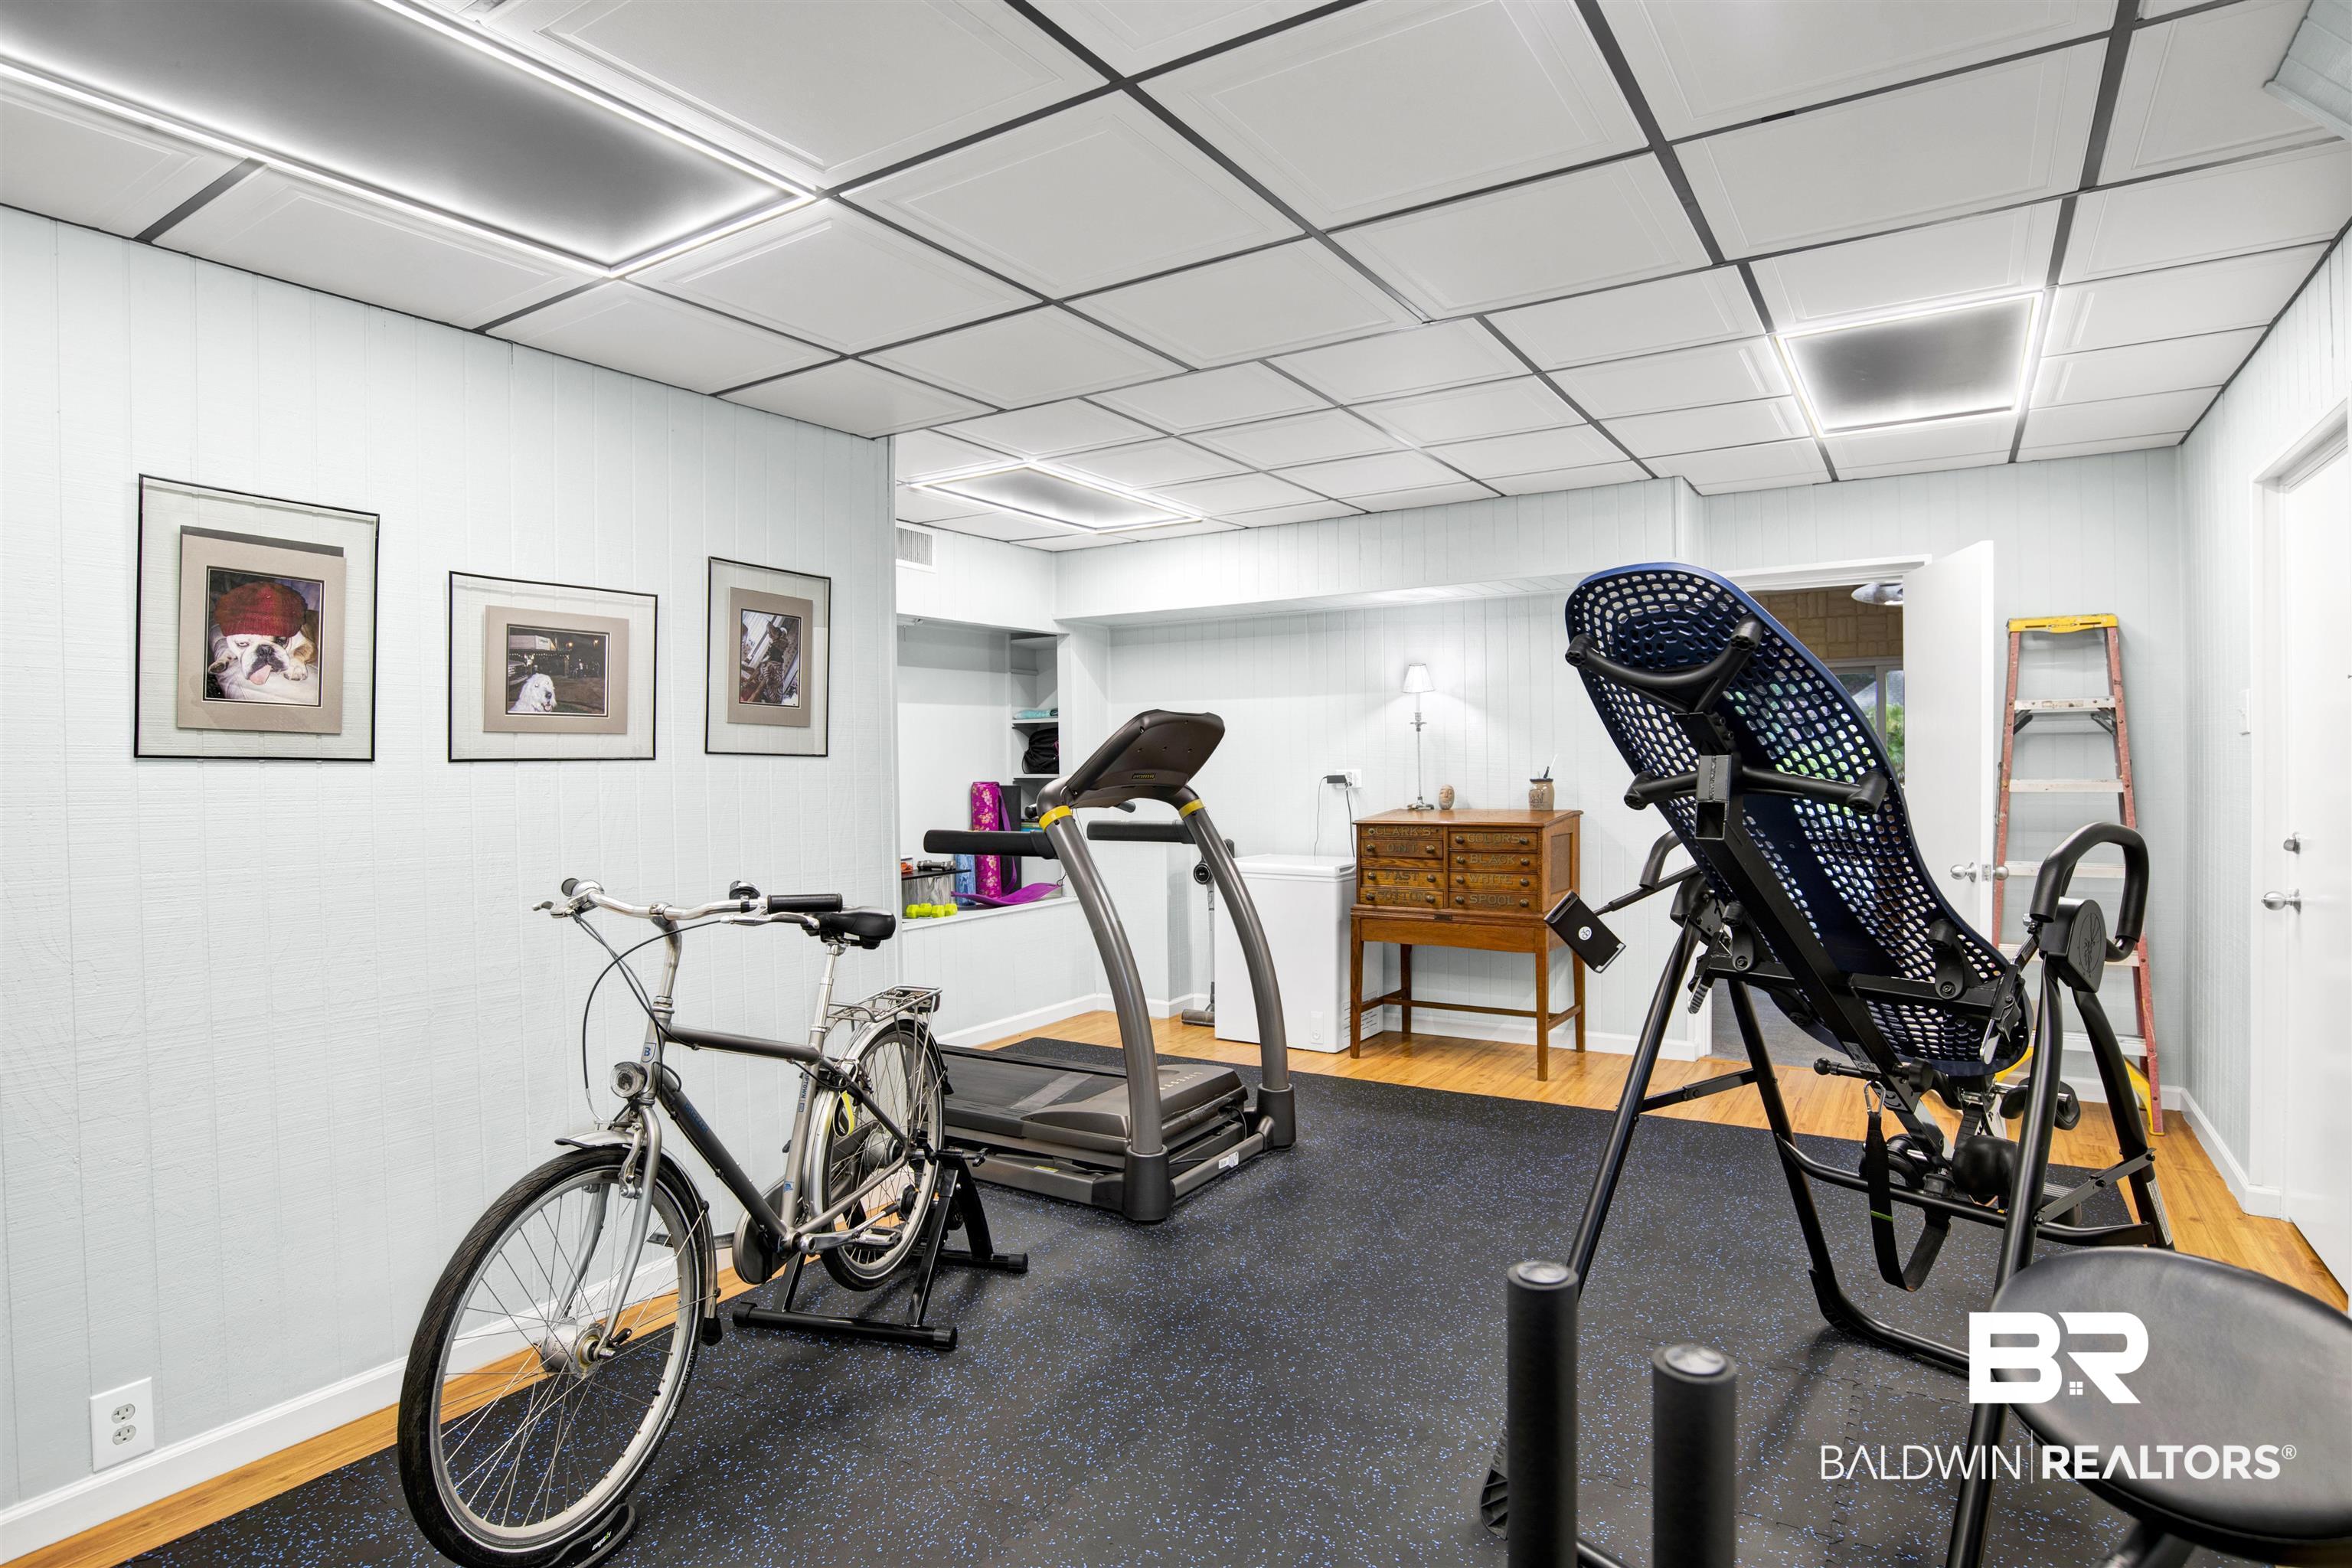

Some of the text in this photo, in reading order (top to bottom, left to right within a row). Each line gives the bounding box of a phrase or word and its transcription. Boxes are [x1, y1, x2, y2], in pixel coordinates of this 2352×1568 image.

[1376, 827, 1431, 836] CLARK'S
[1467, 832, 1520, 844] COLORS
[1470, 854, 1516, 864] BLACK
[1383, 871, 1419, 881] FAST
[1468, 873, 1514, 884] WHITE
[1470, 894, 1515, 906] SPOOL
